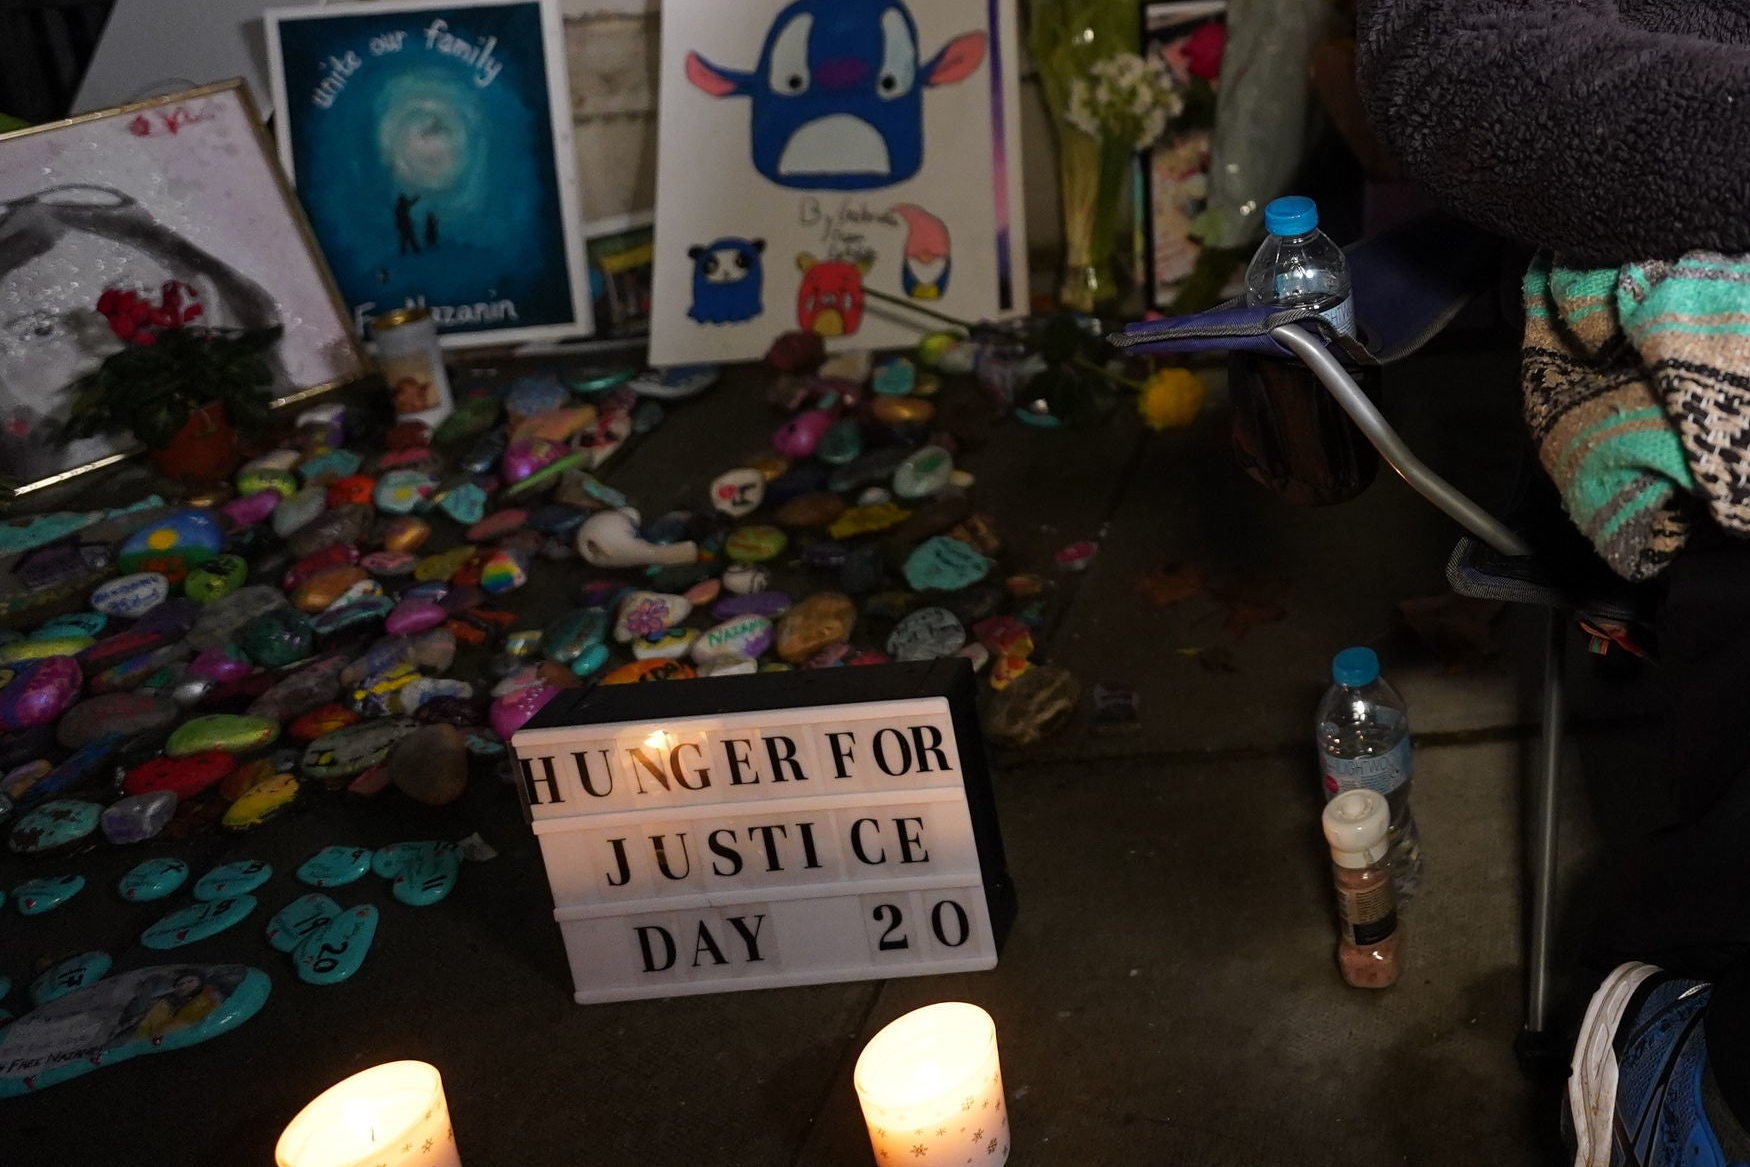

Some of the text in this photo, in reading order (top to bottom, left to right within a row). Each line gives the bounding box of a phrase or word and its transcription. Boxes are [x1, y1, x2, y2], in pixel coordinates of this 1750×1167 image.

[368, 30, 409, 57] our
[423, 18, 503, 88] family
[518, 724, 953, 806] HUNGER FOR
[605, 816, 931, 887] JUSTICE
[313, 940, 349, 974] 20
[634, 899, 970, 973] DAY 20
